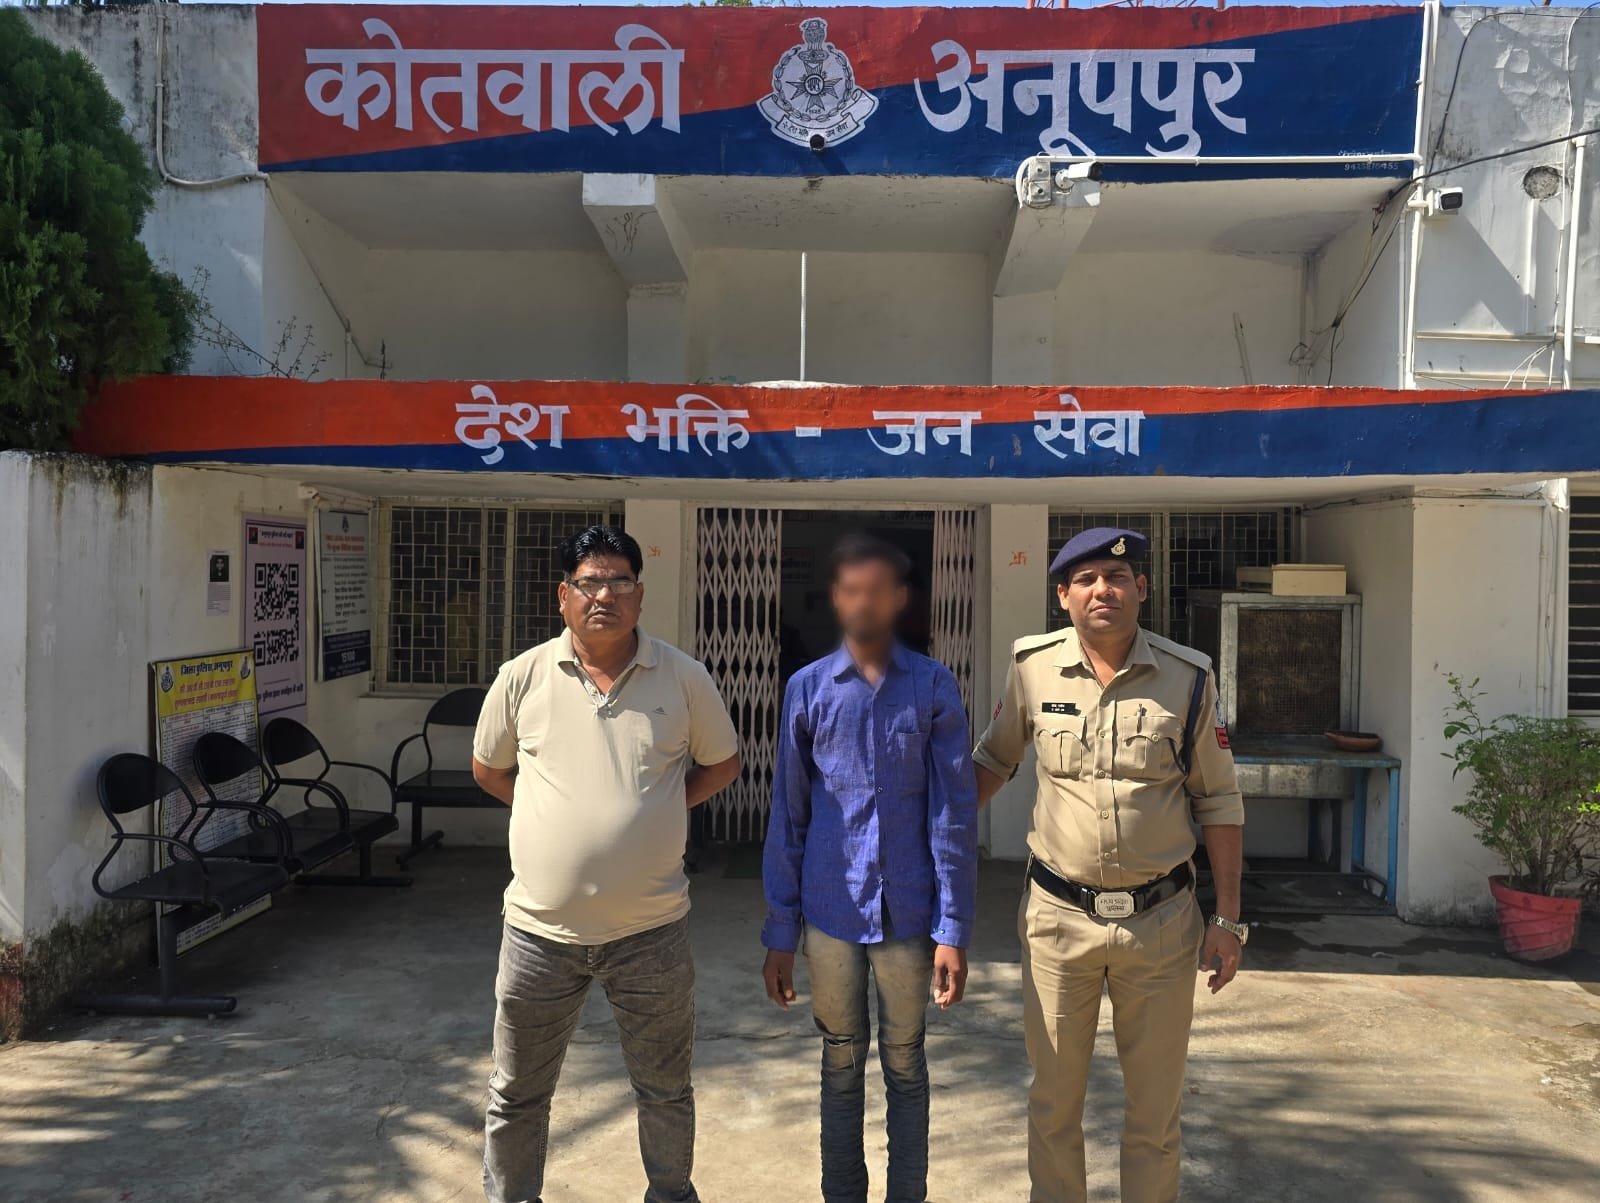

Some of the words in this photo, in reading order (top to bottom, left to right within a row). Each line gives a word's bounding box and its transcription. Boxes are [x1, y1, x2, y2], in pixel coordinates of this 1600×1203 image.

[304, 17, 686, 137] कोतवाली
[913, 39, 1256, 158] अनूपपुर
[455, 384, 571, 465] देश
[620, 393, 750, 457] भक्ति
[795, 426, 822, 437] -
[867, 410, 982, 456] जन
[1033, 393, 1146, 459] सेवा
